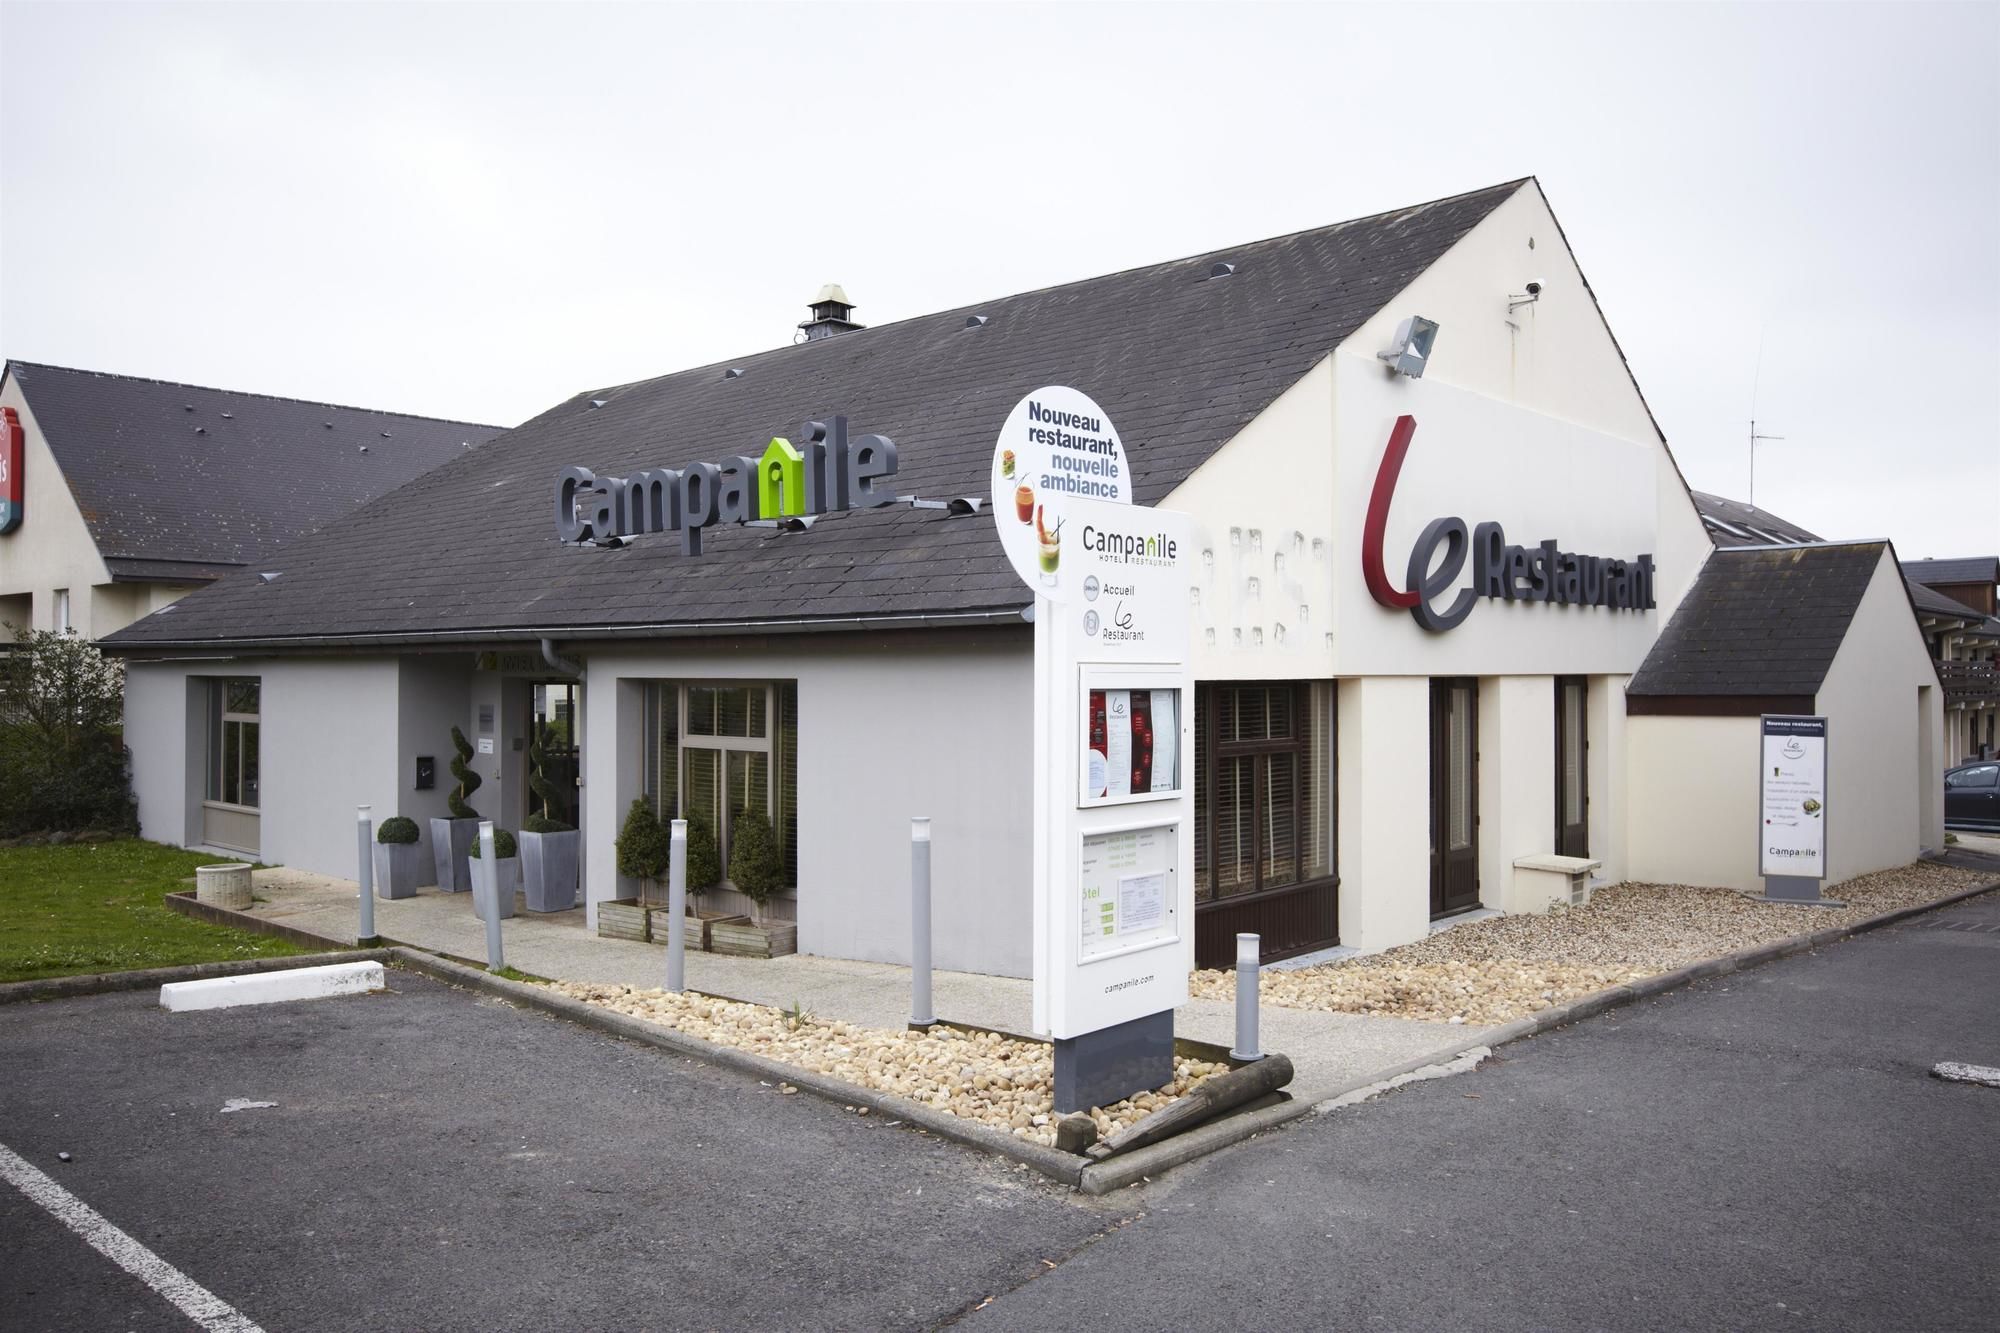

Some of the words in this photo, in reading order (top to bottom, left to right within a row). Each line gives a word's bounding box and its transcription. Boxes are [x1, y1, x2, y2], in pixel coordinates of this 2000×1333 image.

[1029, 400, 1100, 433] Nouveau
[1029, 427, 1118, 461] restaurant,
[1052, 454, 1119, 478] nouvelle
[555, 415, 899, 557] Campanile
[1040, 473, 1118, 499] ambiance
[1362, 414, 1480, 632] Le
[1473, 521, 1657, 610] Restaurant
[1083, 525, 1176, 564] Campanile
[1099, 555, 1123, 564] HOTEL
[1131, 557, 1176, 568] RESTAURANT
[1103, 583, 1135, 596] Accueil
[1103, 628, 1144, 641] Restaurant
[1769, 847, 1817, 858] Campanile
[1104, 974, 1154, 994] campanile.com
